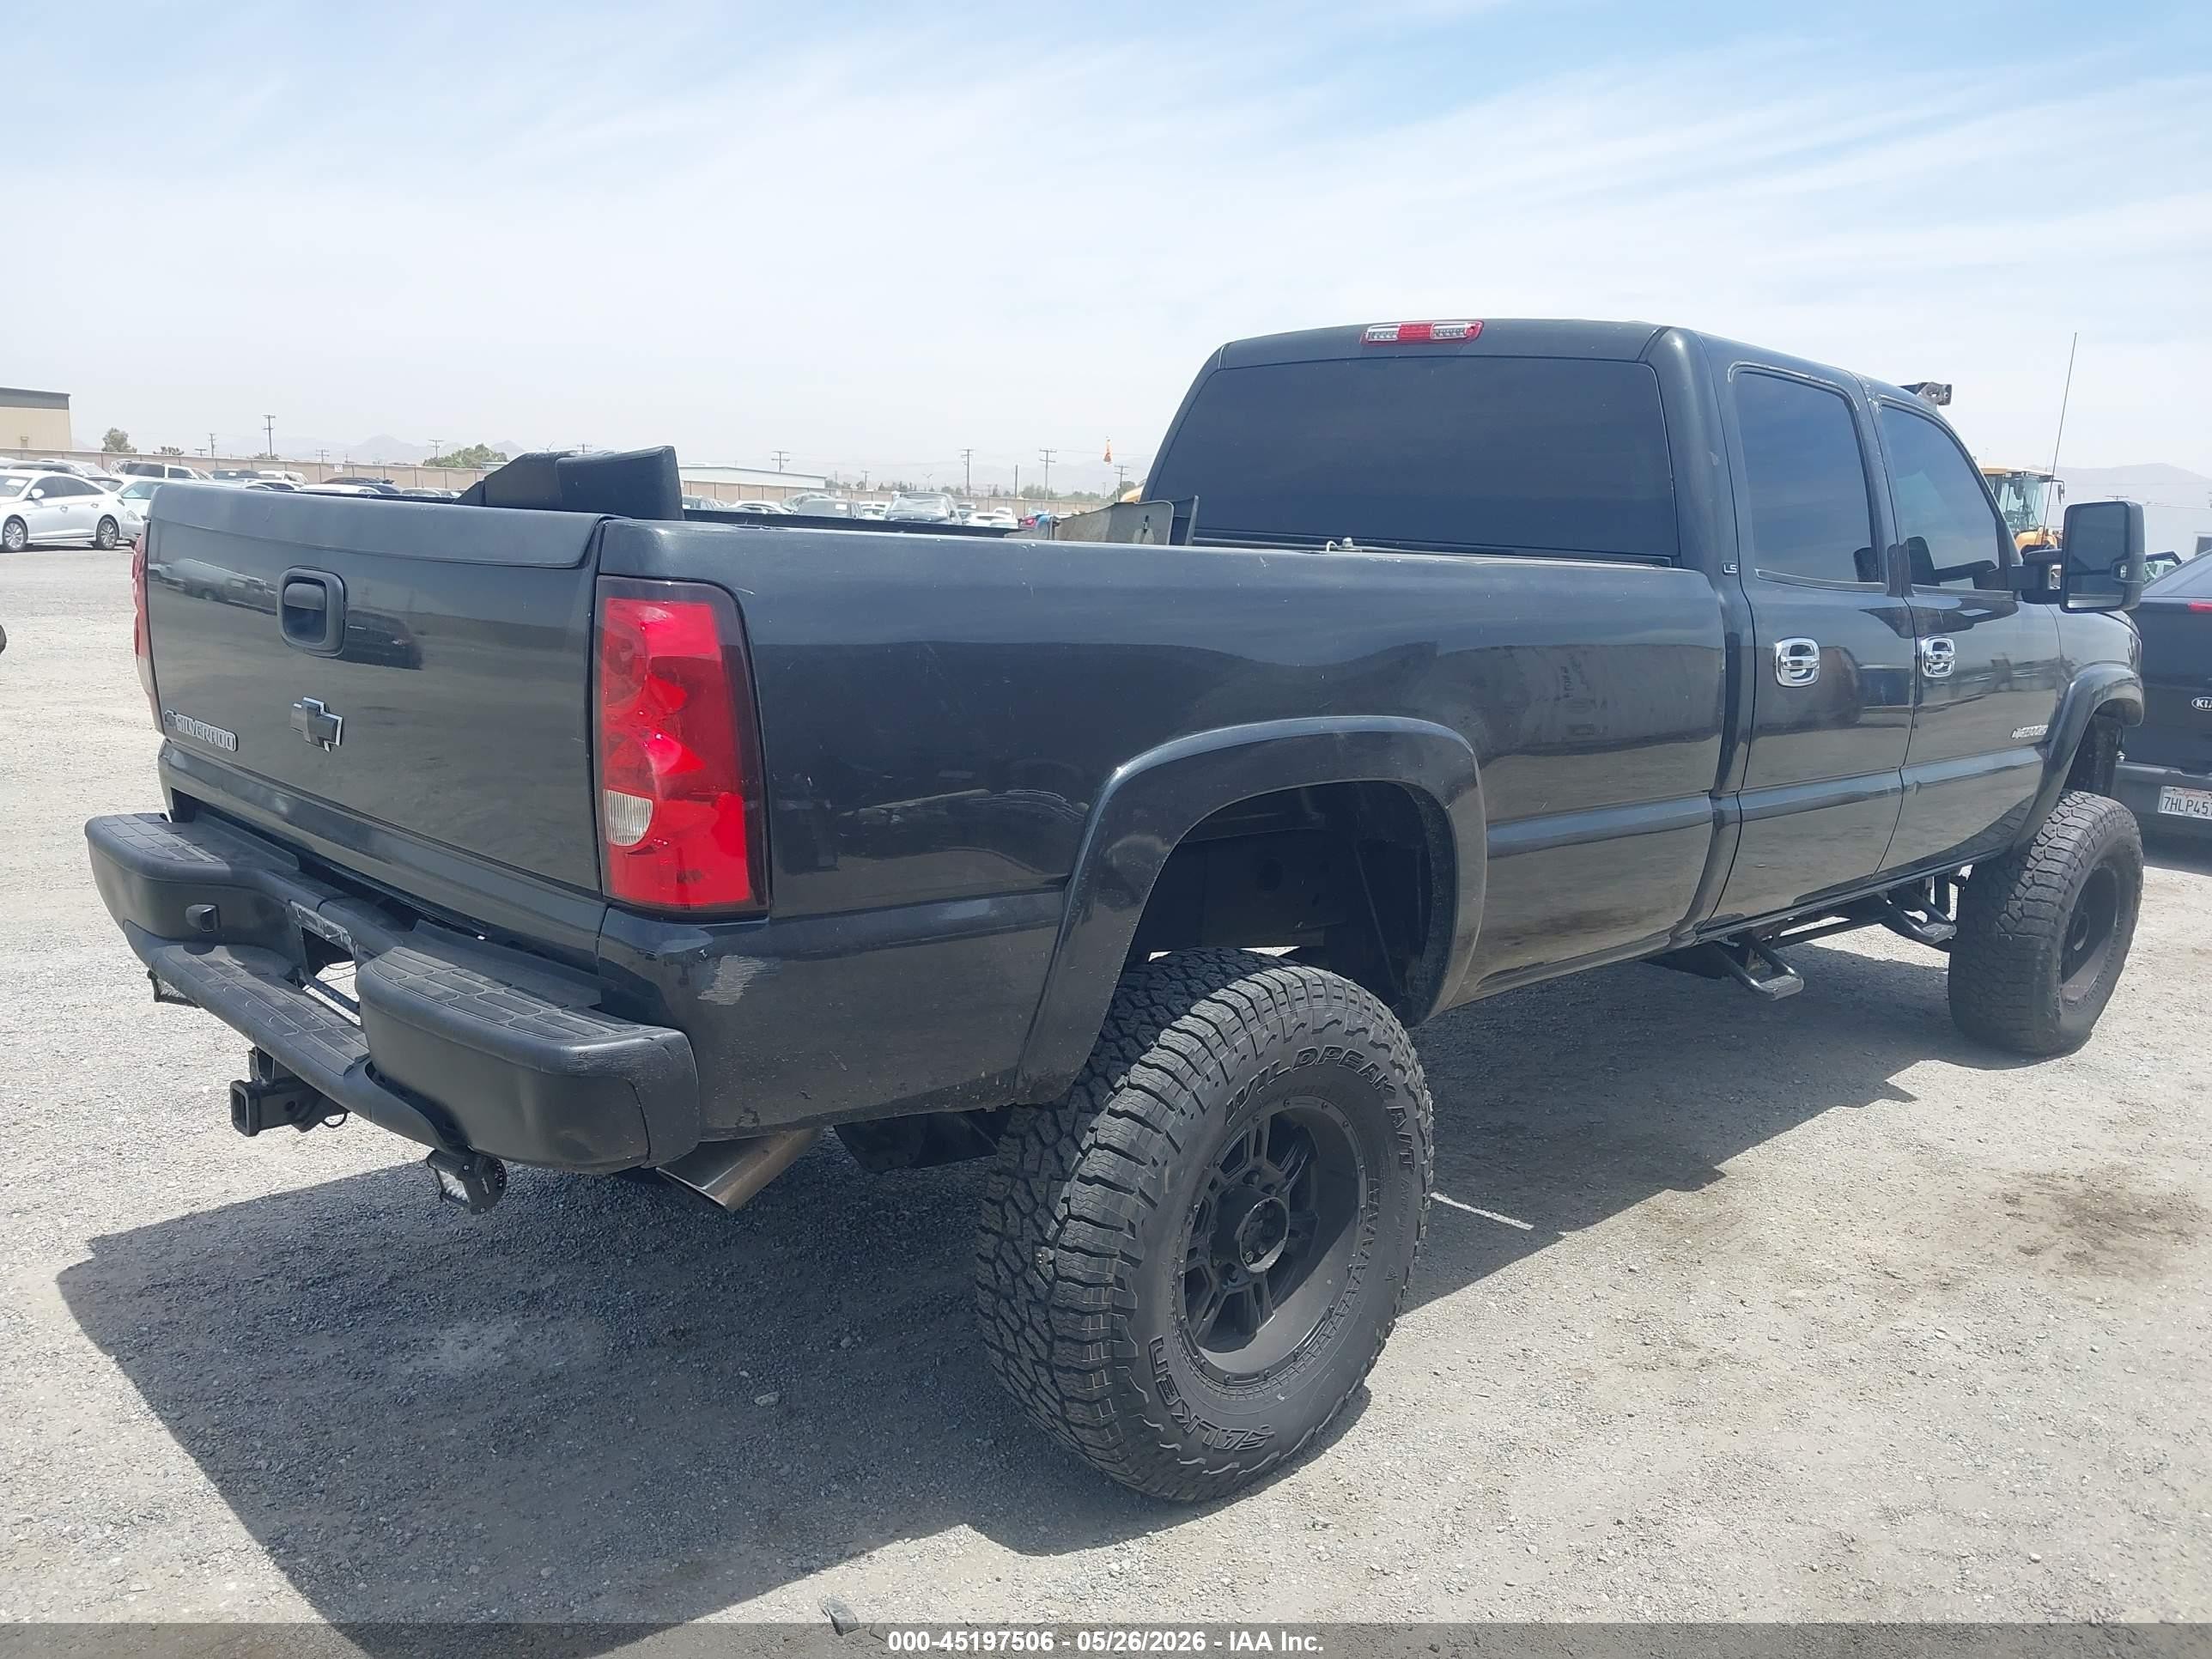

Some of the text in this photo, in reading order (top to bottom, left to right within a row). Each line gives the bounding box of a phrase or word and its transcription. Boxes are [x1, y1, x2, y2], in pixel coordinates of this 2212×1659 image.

[1723, 563, 1737, 574] LS
[176, 714, 236, 752] SILVERADO
[2164, 797, 2212, 815] 7HLP45
[1224, 1045, 1396, 1127] WILDPEAK
[1147, 1335, 1276, 1450] FALKEN
